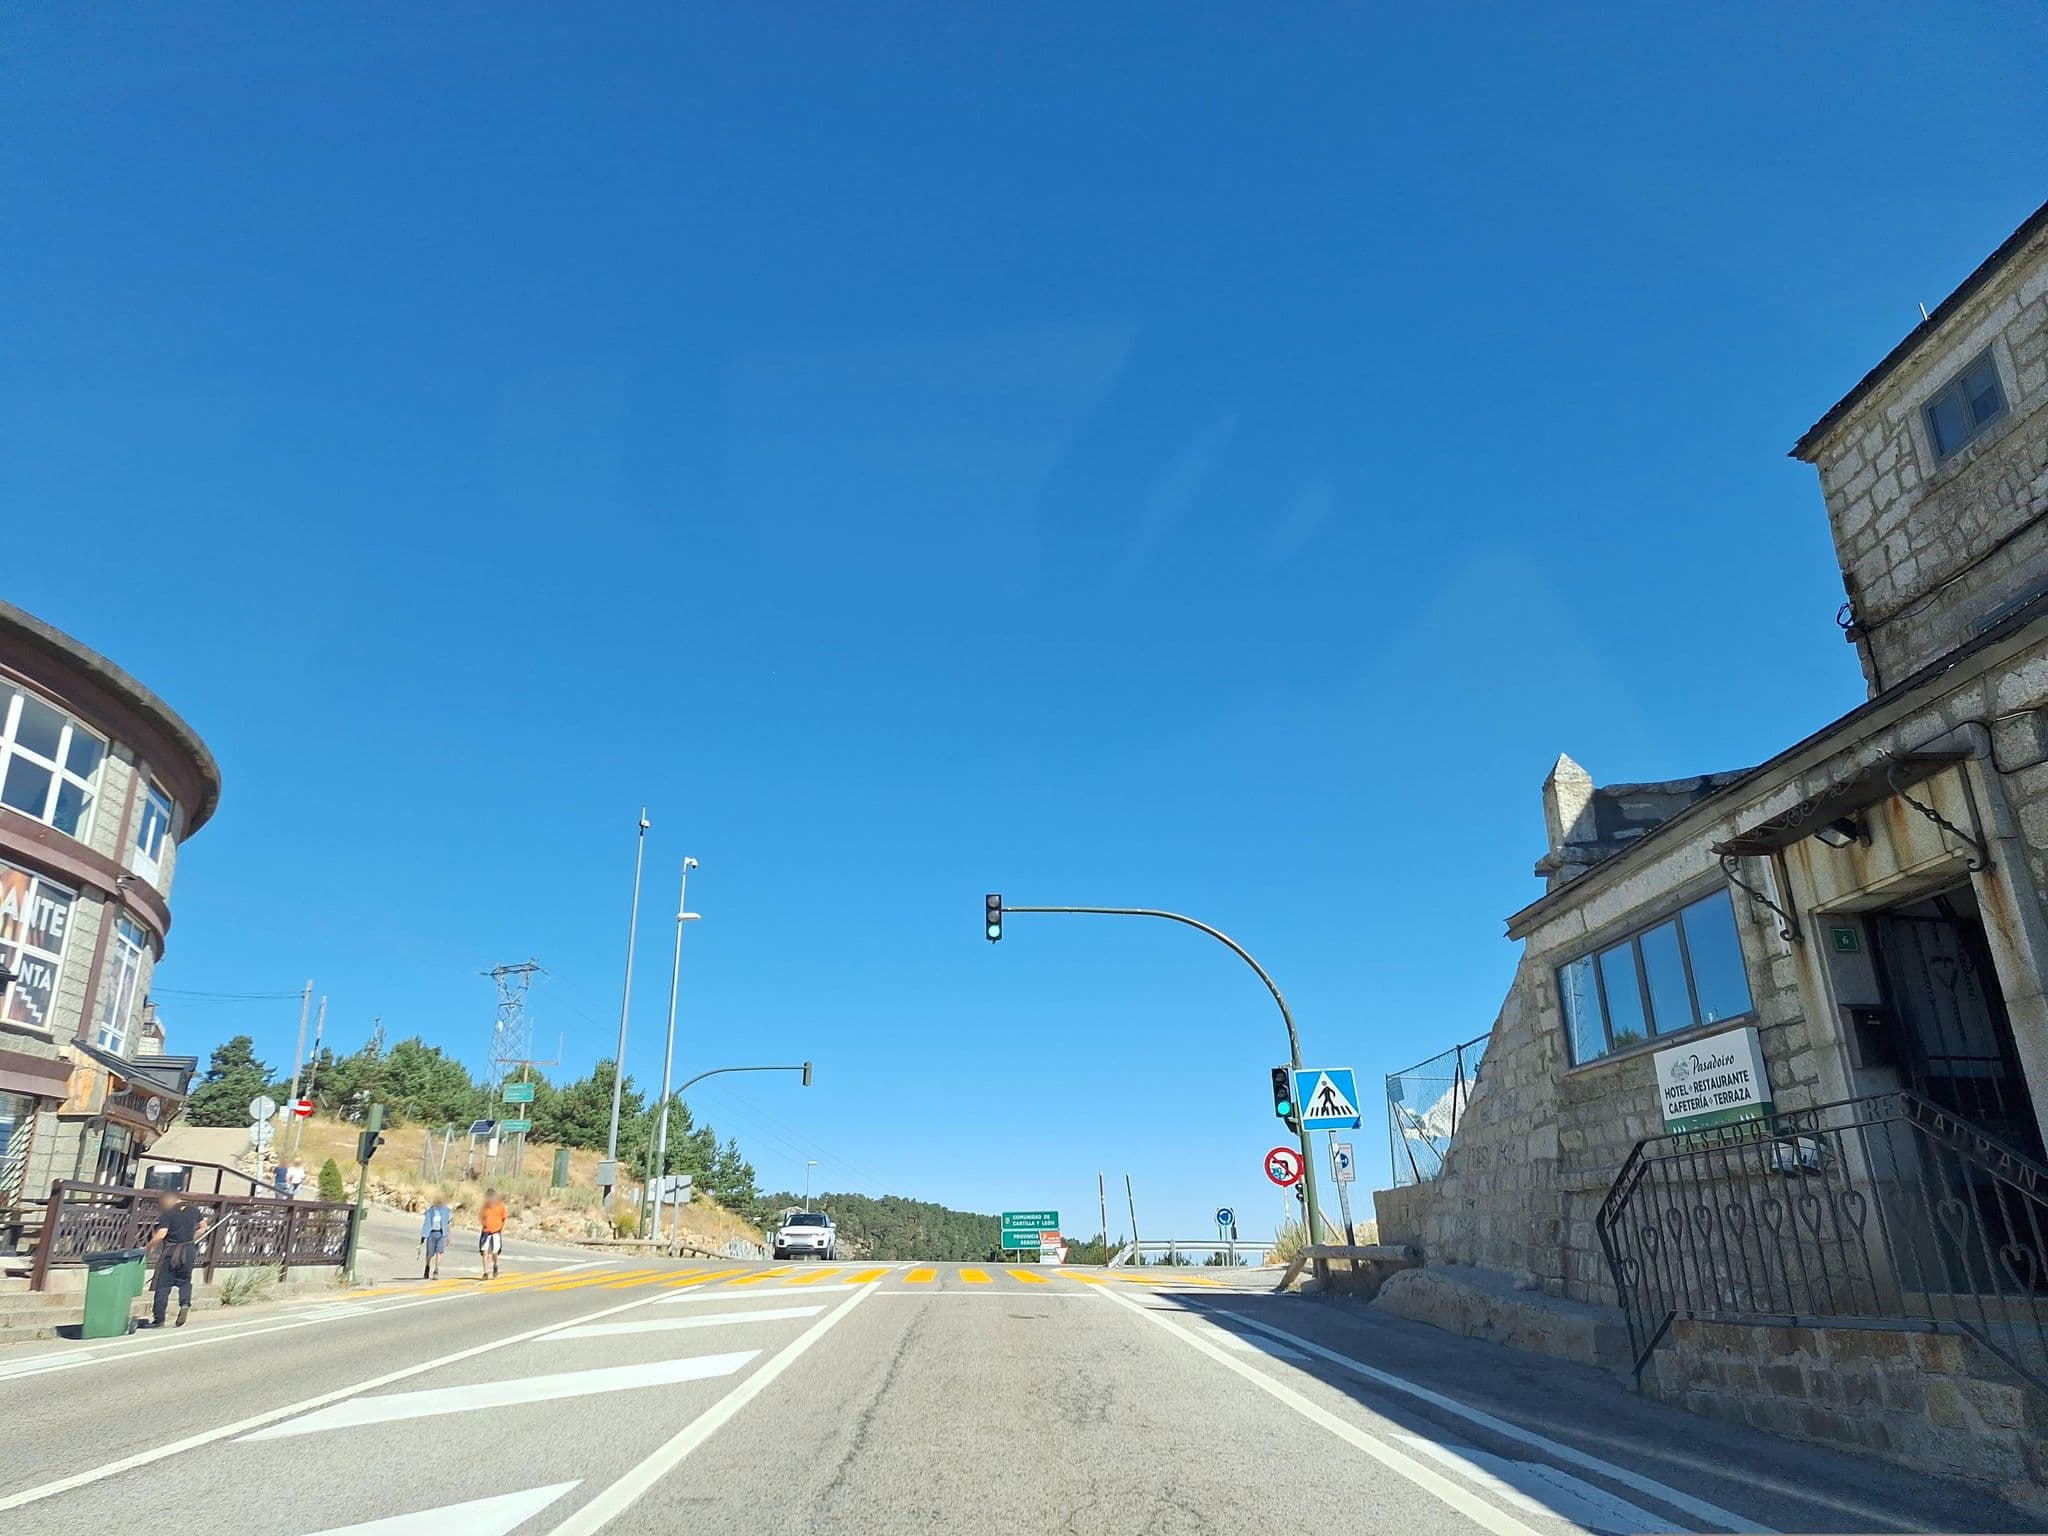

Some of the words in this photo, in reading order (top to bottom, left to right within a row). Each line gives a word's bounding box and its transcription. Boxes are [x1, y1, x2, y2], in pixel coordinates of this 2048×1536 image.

[0, 878, 67, 938] ANTE
[1842, 935, 1849, 945] 6
[1689, 1053, 1735, 1075] Pasadoiro
[1664, 1086, 1689, 1100] HOTEL
[1693, 1070, 1750, 1094] RESTAURANTE
[1668, 1094, 1709, 1115] CAFETERÍA
[1713, 1087, 1752, 1106] TERRAZA
